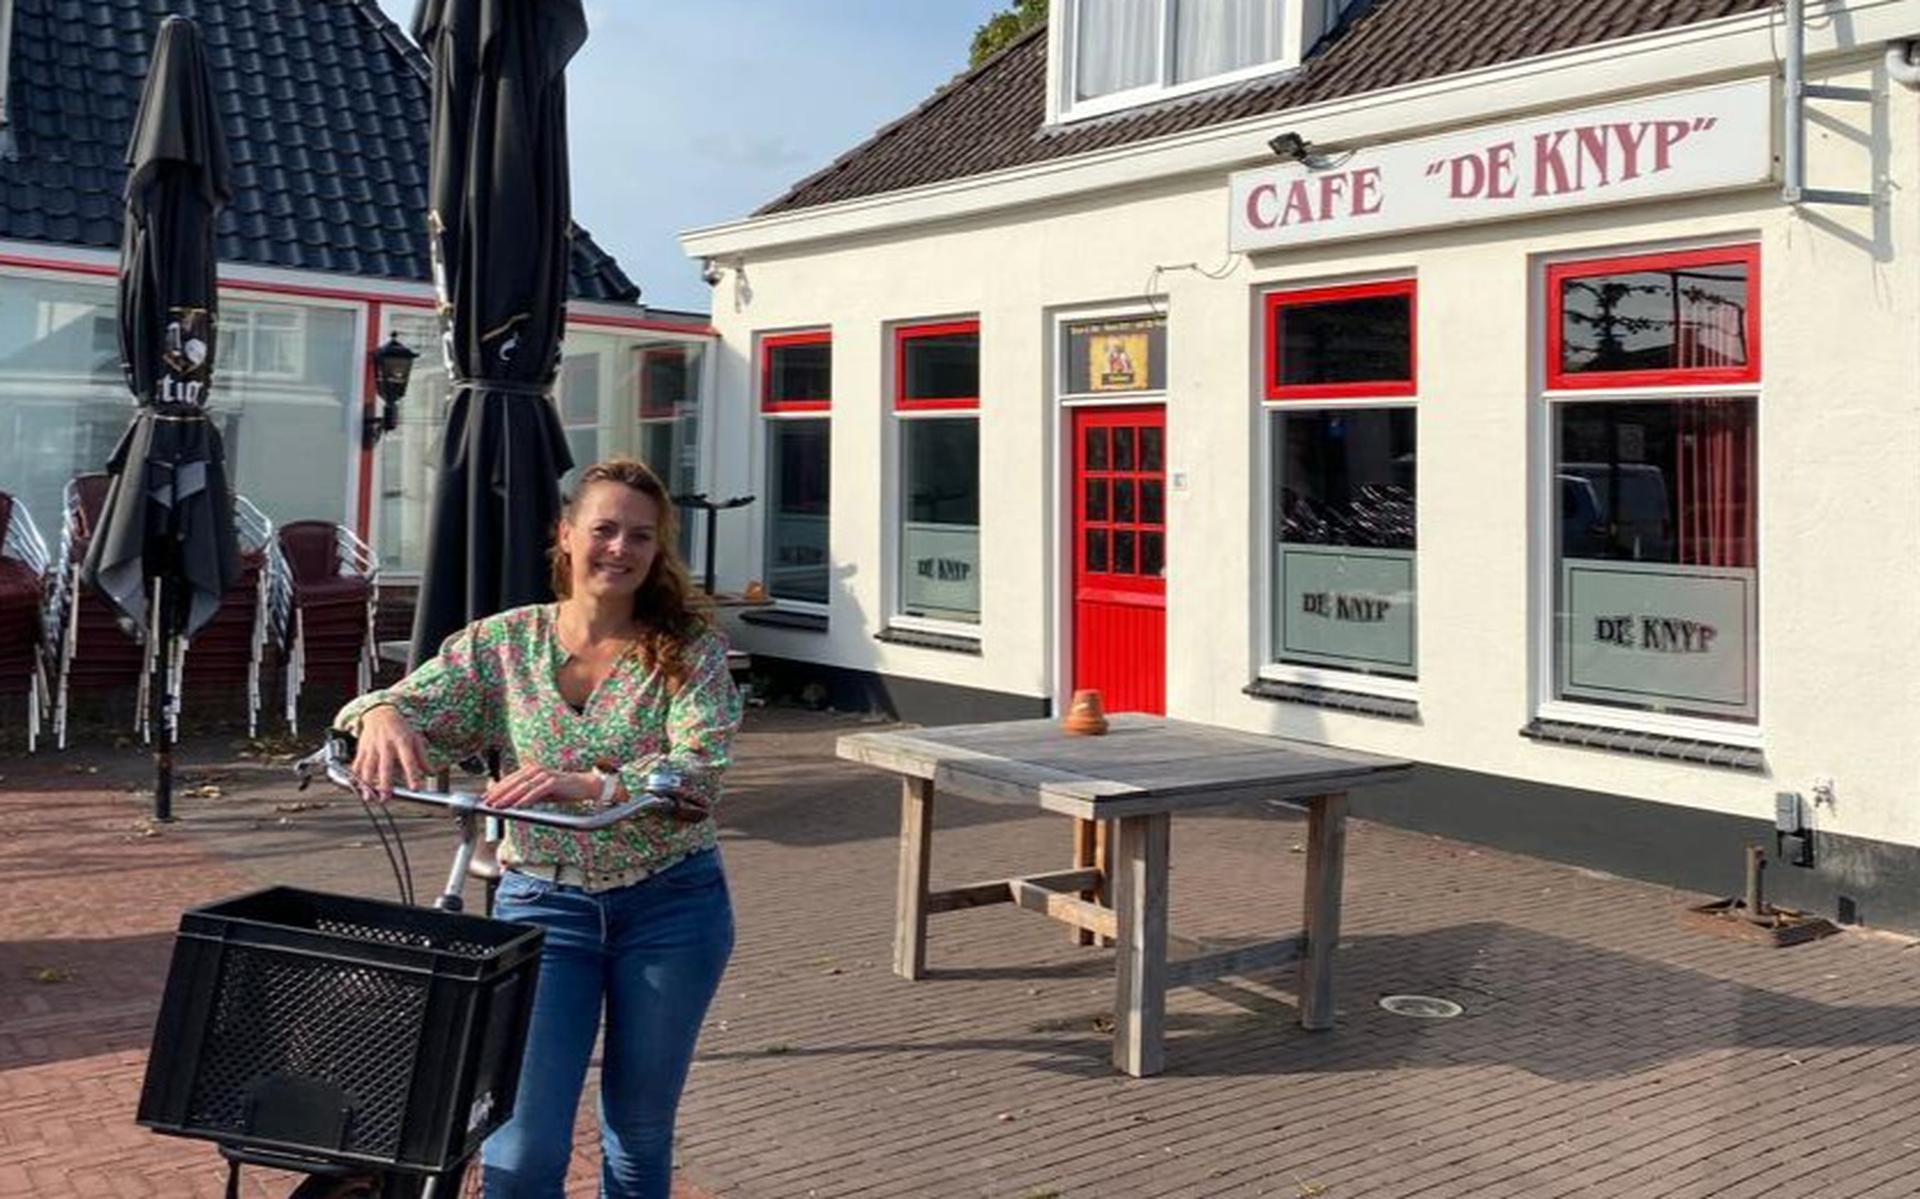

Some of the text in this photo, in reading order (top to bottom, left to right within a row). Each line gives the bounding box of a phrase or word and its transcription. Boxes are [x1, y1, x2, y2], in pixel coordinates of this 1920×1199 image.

[1246, 167, 1383, 231] CAFE
[917, 558, 934, 578] DE
[1303, 592, 1390, 622] DE KNYP
[1595, 616, 1718, 653] DE KNYP
